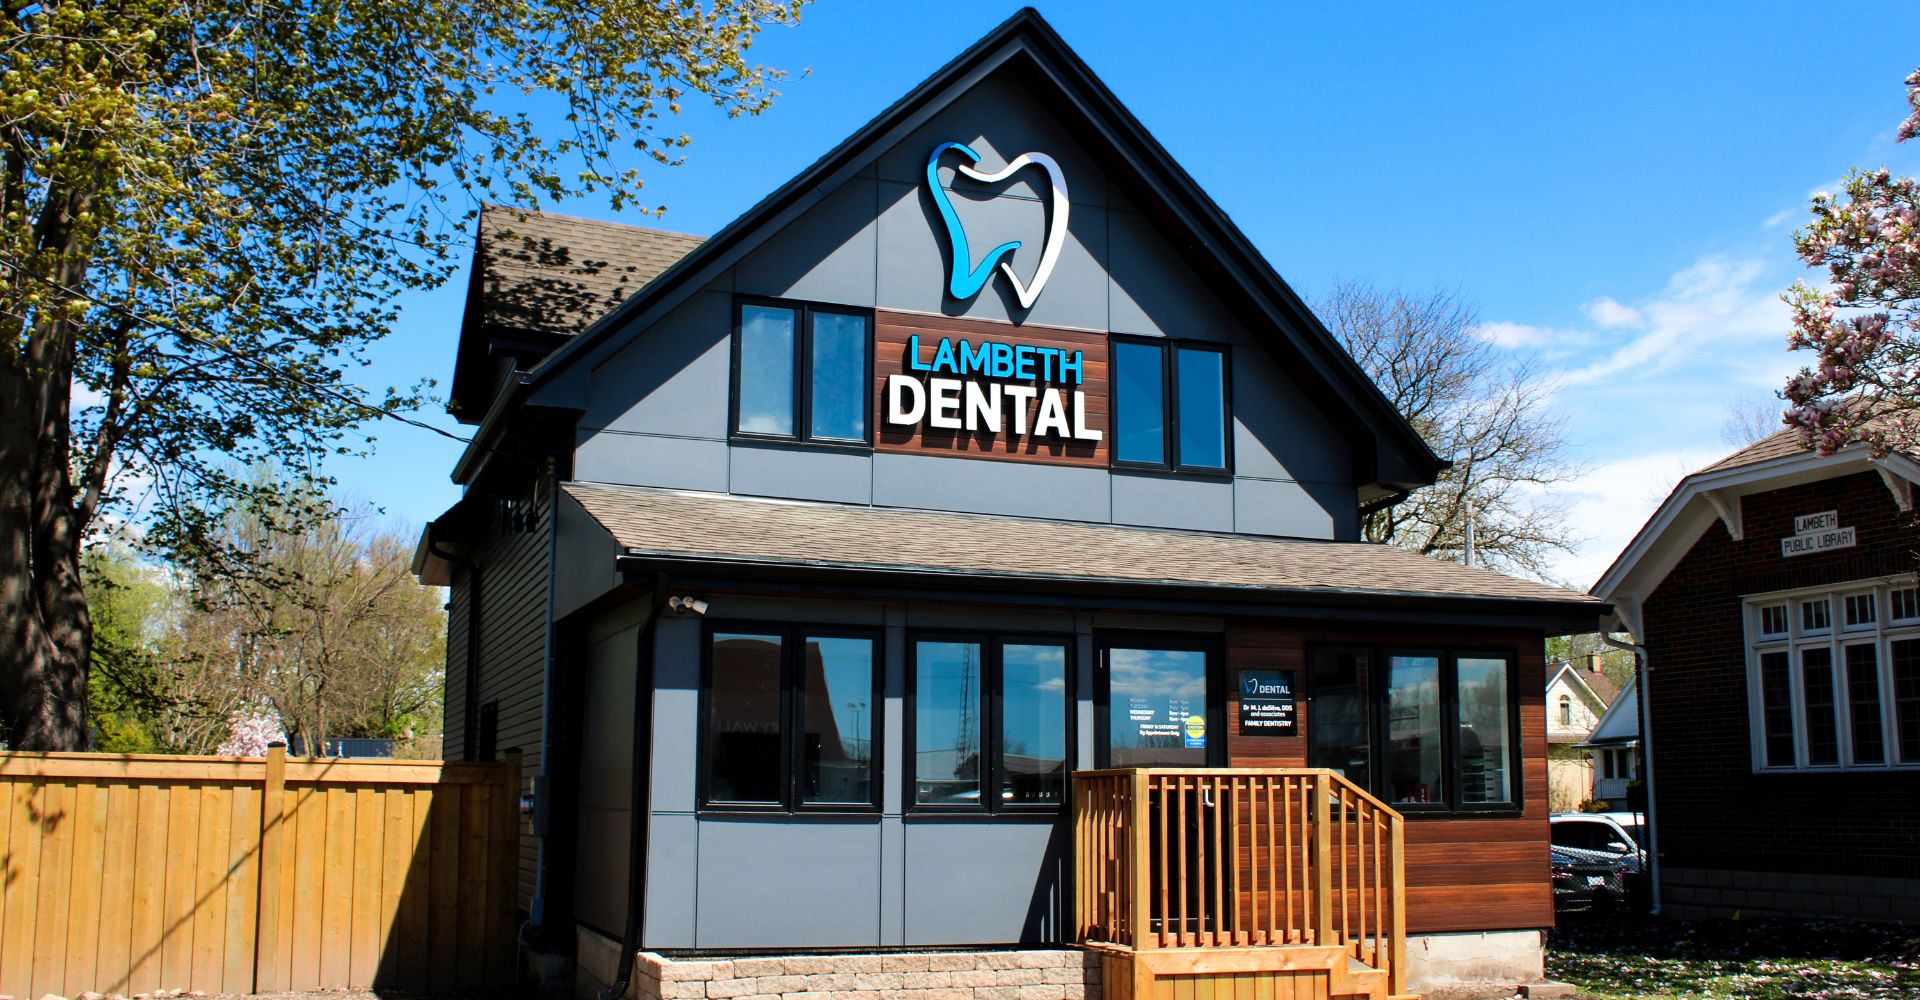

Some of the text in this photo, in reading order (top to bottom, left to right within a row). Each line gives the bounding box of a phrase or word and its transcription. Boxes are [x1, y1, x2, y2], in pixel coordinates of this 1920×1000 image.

[911, 335, 1083, 385] LAMBETH
[889, 374, 1103, 441] DENTAL
[1796, 513, 1836, 532] LAMBETH
[1784, 530, 1853, 554] PUBLIC LIBRARY
[1259, 685, 1290, 694] DENTAL
